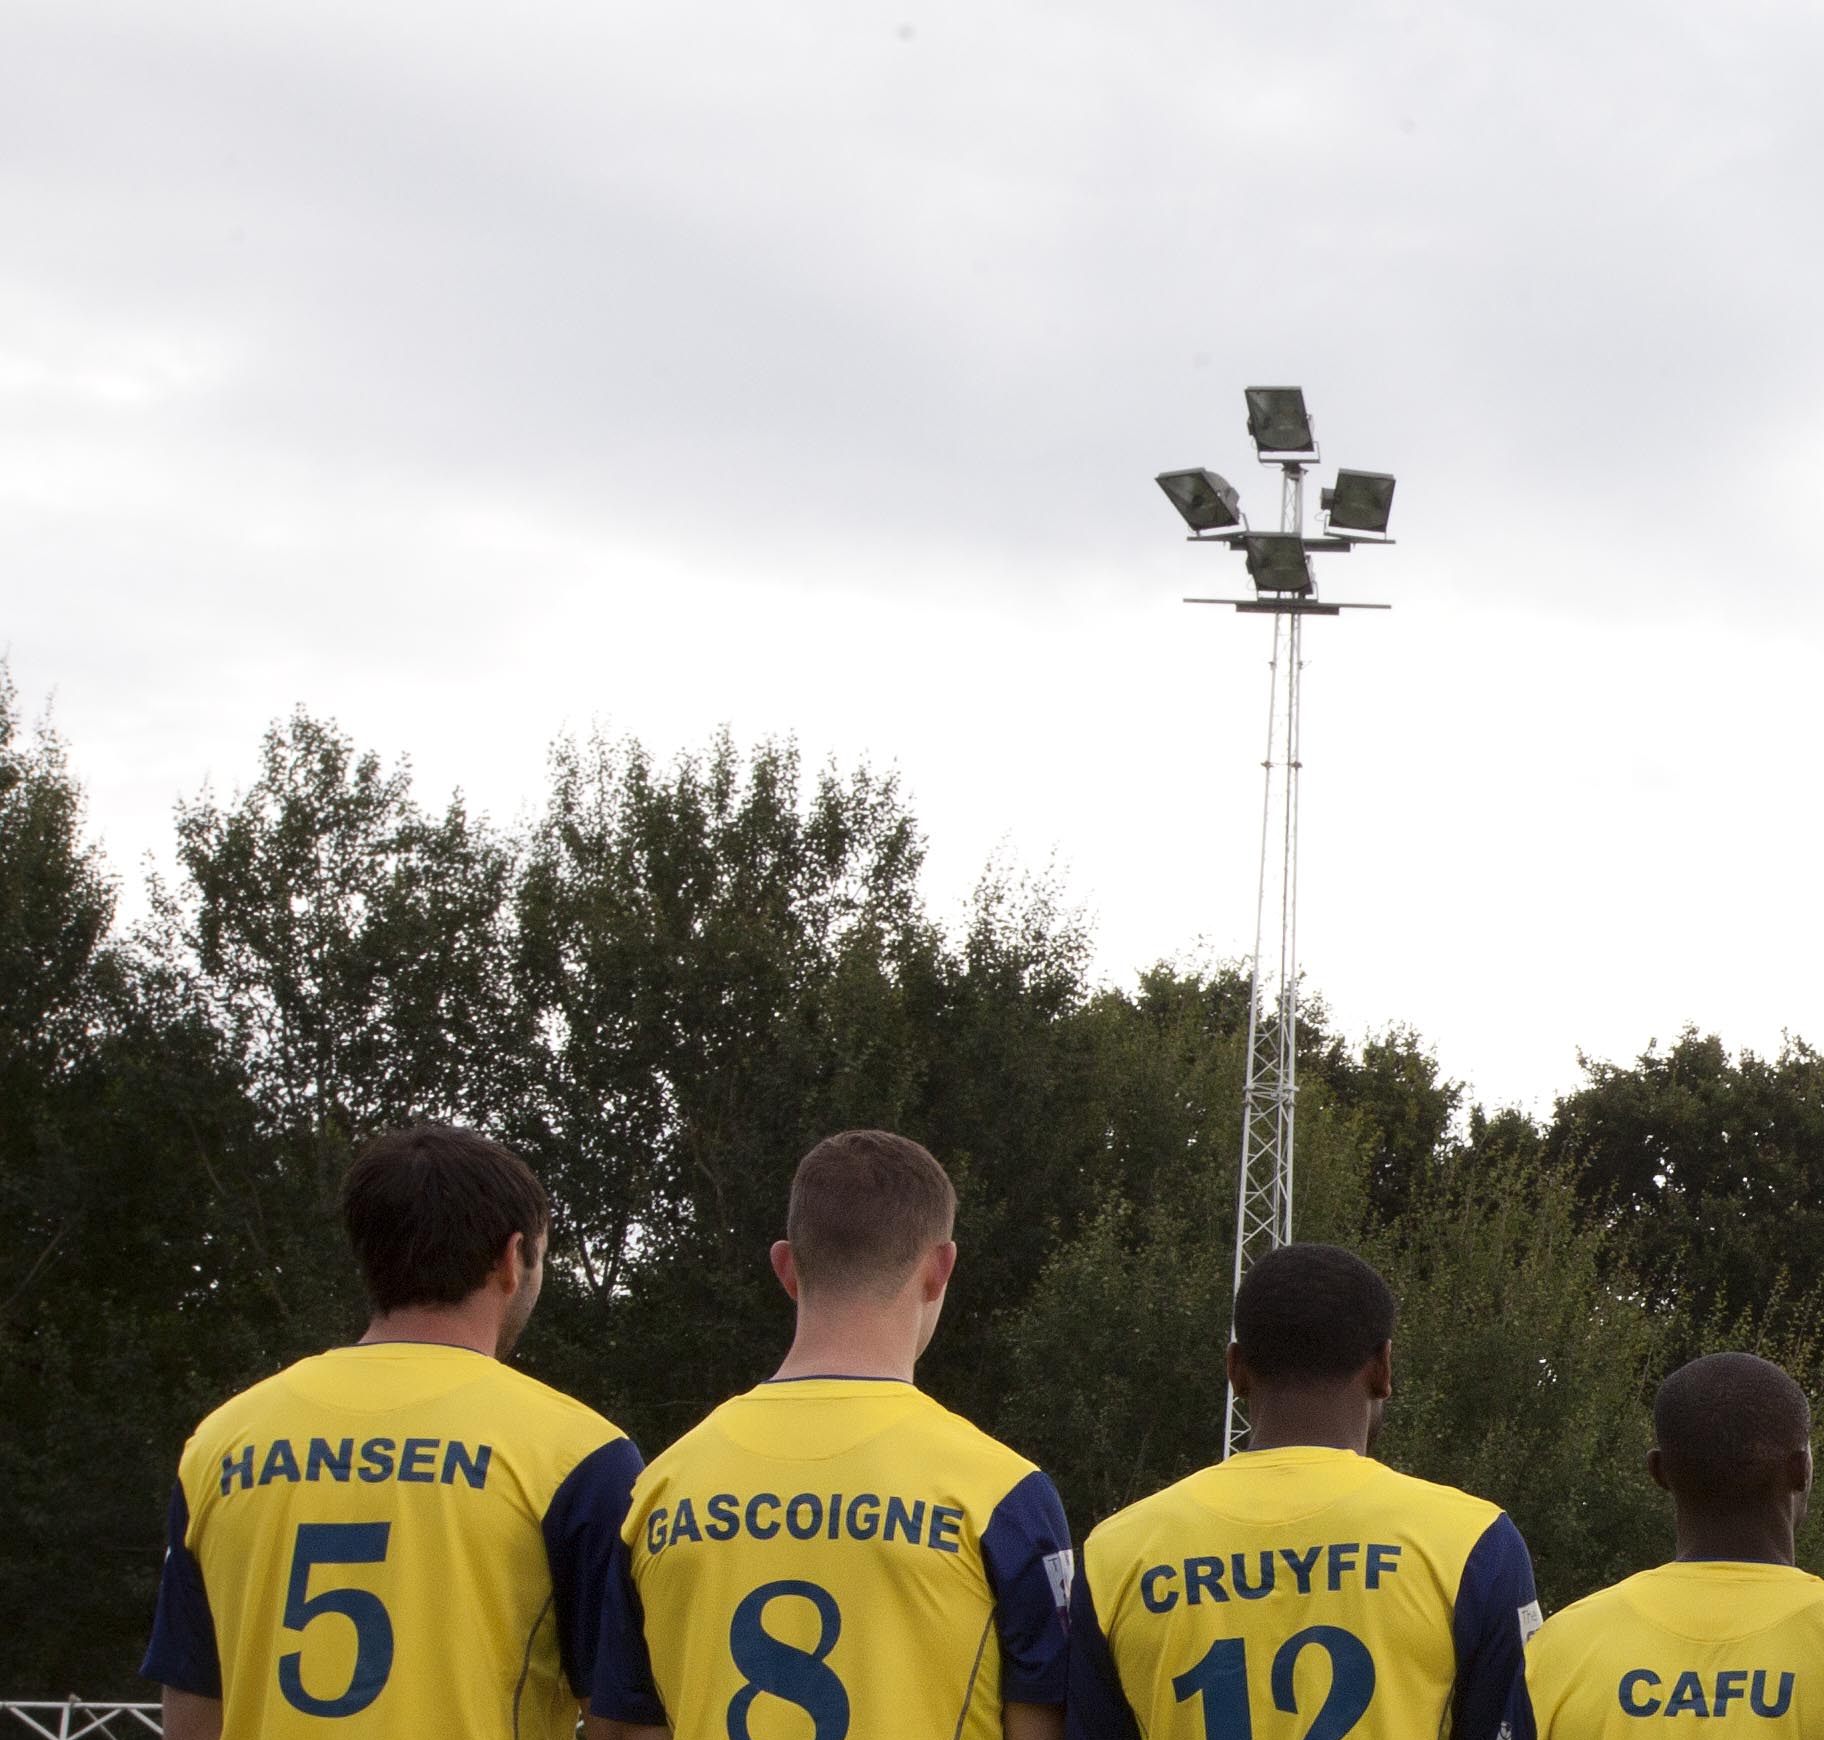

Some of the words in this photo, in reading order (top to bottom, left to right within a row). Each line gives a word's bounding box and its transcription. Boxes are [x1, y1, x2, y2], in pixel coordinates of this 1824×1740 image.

[221, 1438, 490, 1494] HANSEN
[649, 1494, 962, 1553] GASCOIGNE
[1141, 1544, 1400, 1613] CRUYFF
[279, 1522, 393, 1717] 5
[1619, 1670, 1793, 1717] CAFU
